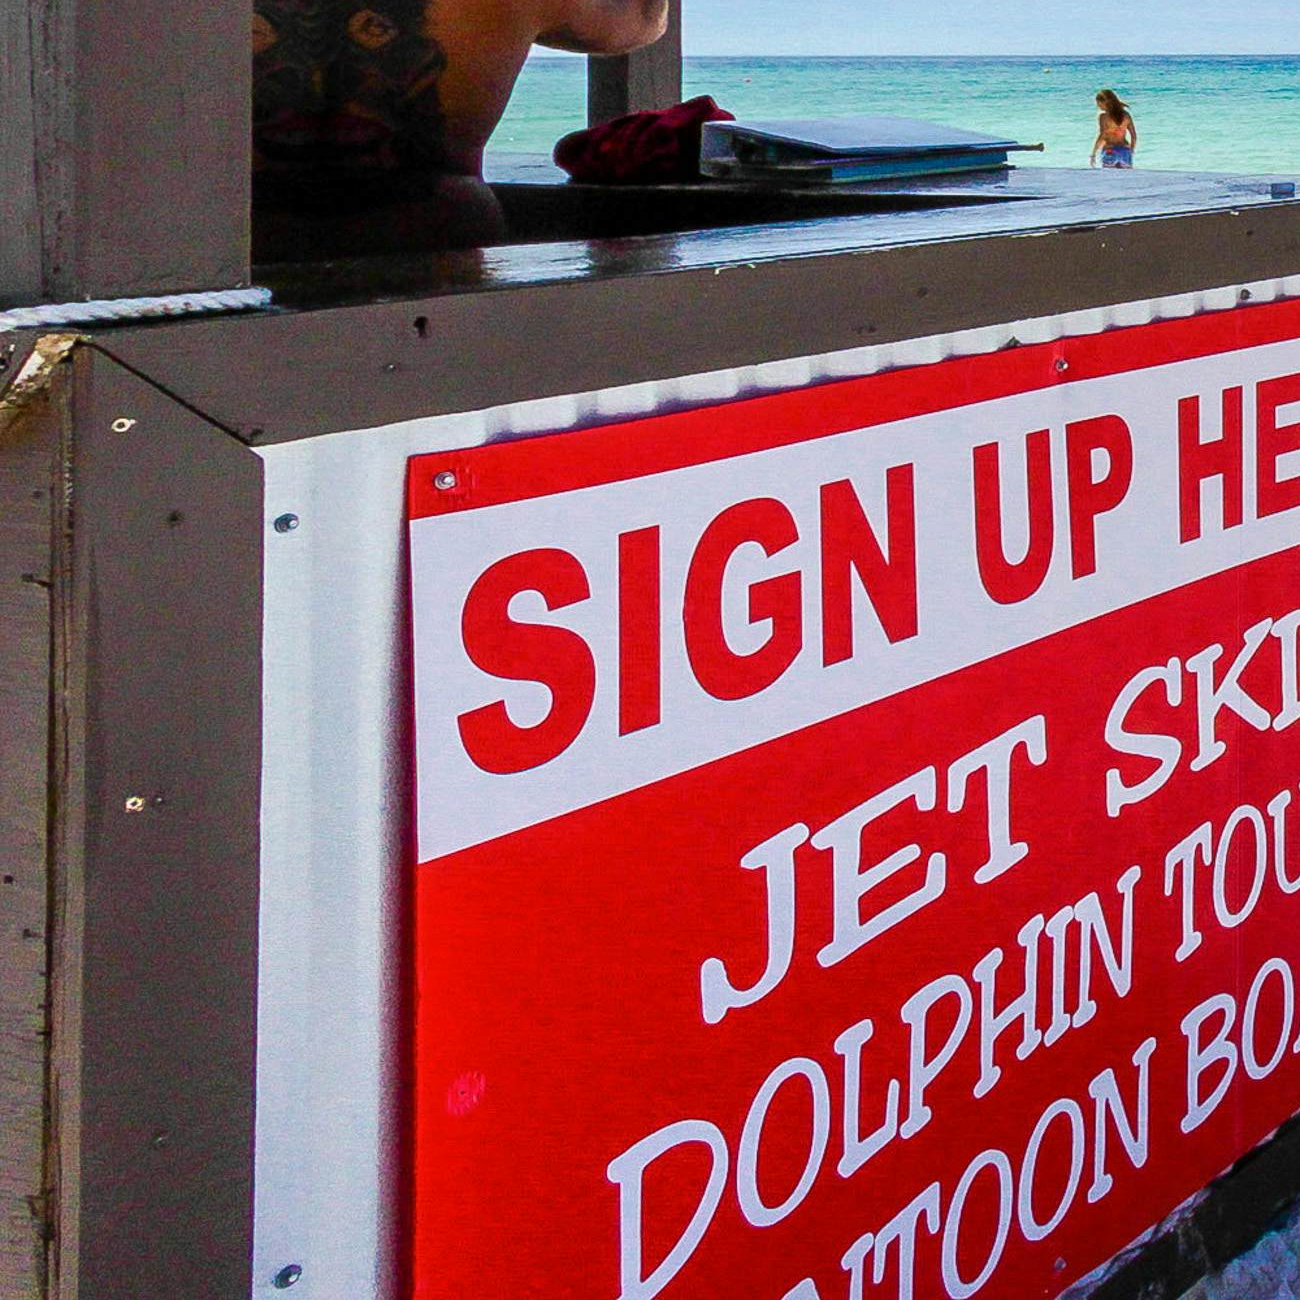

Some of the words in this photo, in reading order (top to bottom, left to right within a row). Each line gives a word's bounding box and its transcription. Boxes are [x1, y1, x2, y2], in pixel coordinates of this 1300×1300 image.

[457, 462, 919, 776] SIGN
[972, 414, 1133, 605] UP
[701, 715, 1047, 1024] JET
[607, 866, 1142, 1300] DOLPHIN
